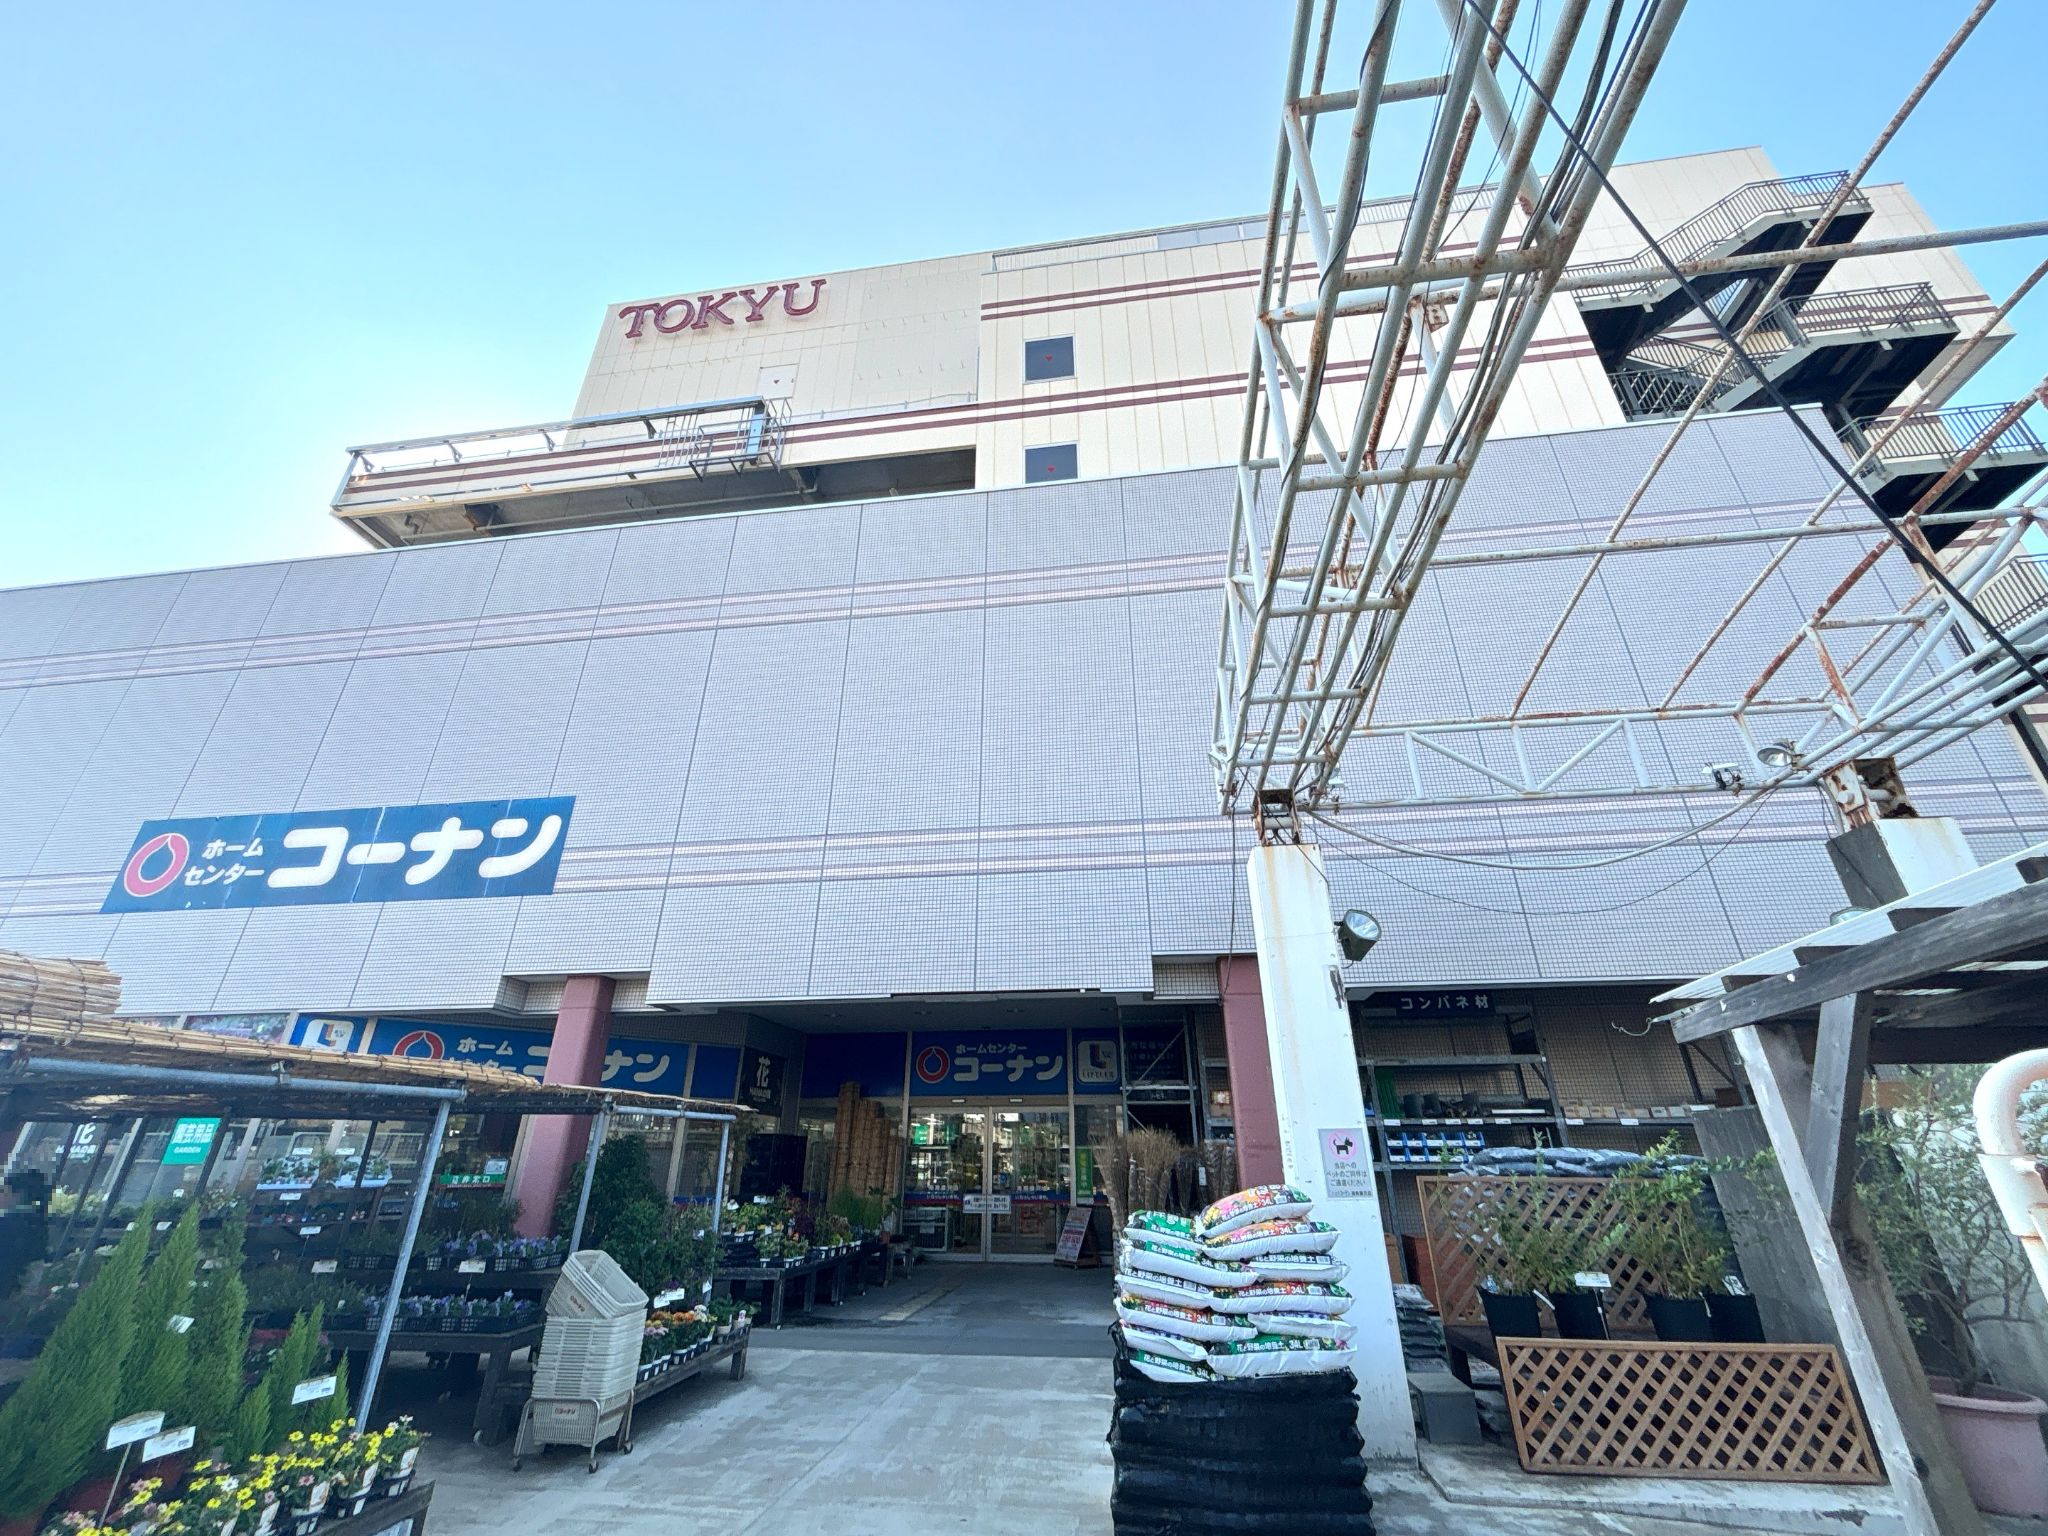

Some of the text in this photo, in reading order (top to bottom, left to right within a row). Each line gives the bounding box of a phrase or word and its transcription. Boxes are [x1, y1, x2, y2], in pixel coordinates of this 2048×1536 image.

[618, 278, 827, 340] TOKYU
[201, 837, 264, 860] ホーム
[266, 814, 563, 889] コーナン
[184, 864, 265, 887] センター
[456, 1036, 514, 1056] ホーム
[955, 1043, 1028, 1055] ホームセンター
[756, 1055, 771, 1088] 花
[953, 1054, 1064, 1083] コーナン
[171, 1122, 215, 1144] 園芸用品
[172, 1146, 202, 1154] GARDEN
[1279, 1225, 1293, 1235] 34L
[1200, 1257, 1214, 1269] 34L
[1290, 1284, 1305, 1295] 34L
[1196, 1311, 1209, 1324] 34L
[1289, 1338, 1304, 1350] 34L
[1196, 1366, 1210, 1379] 34L
